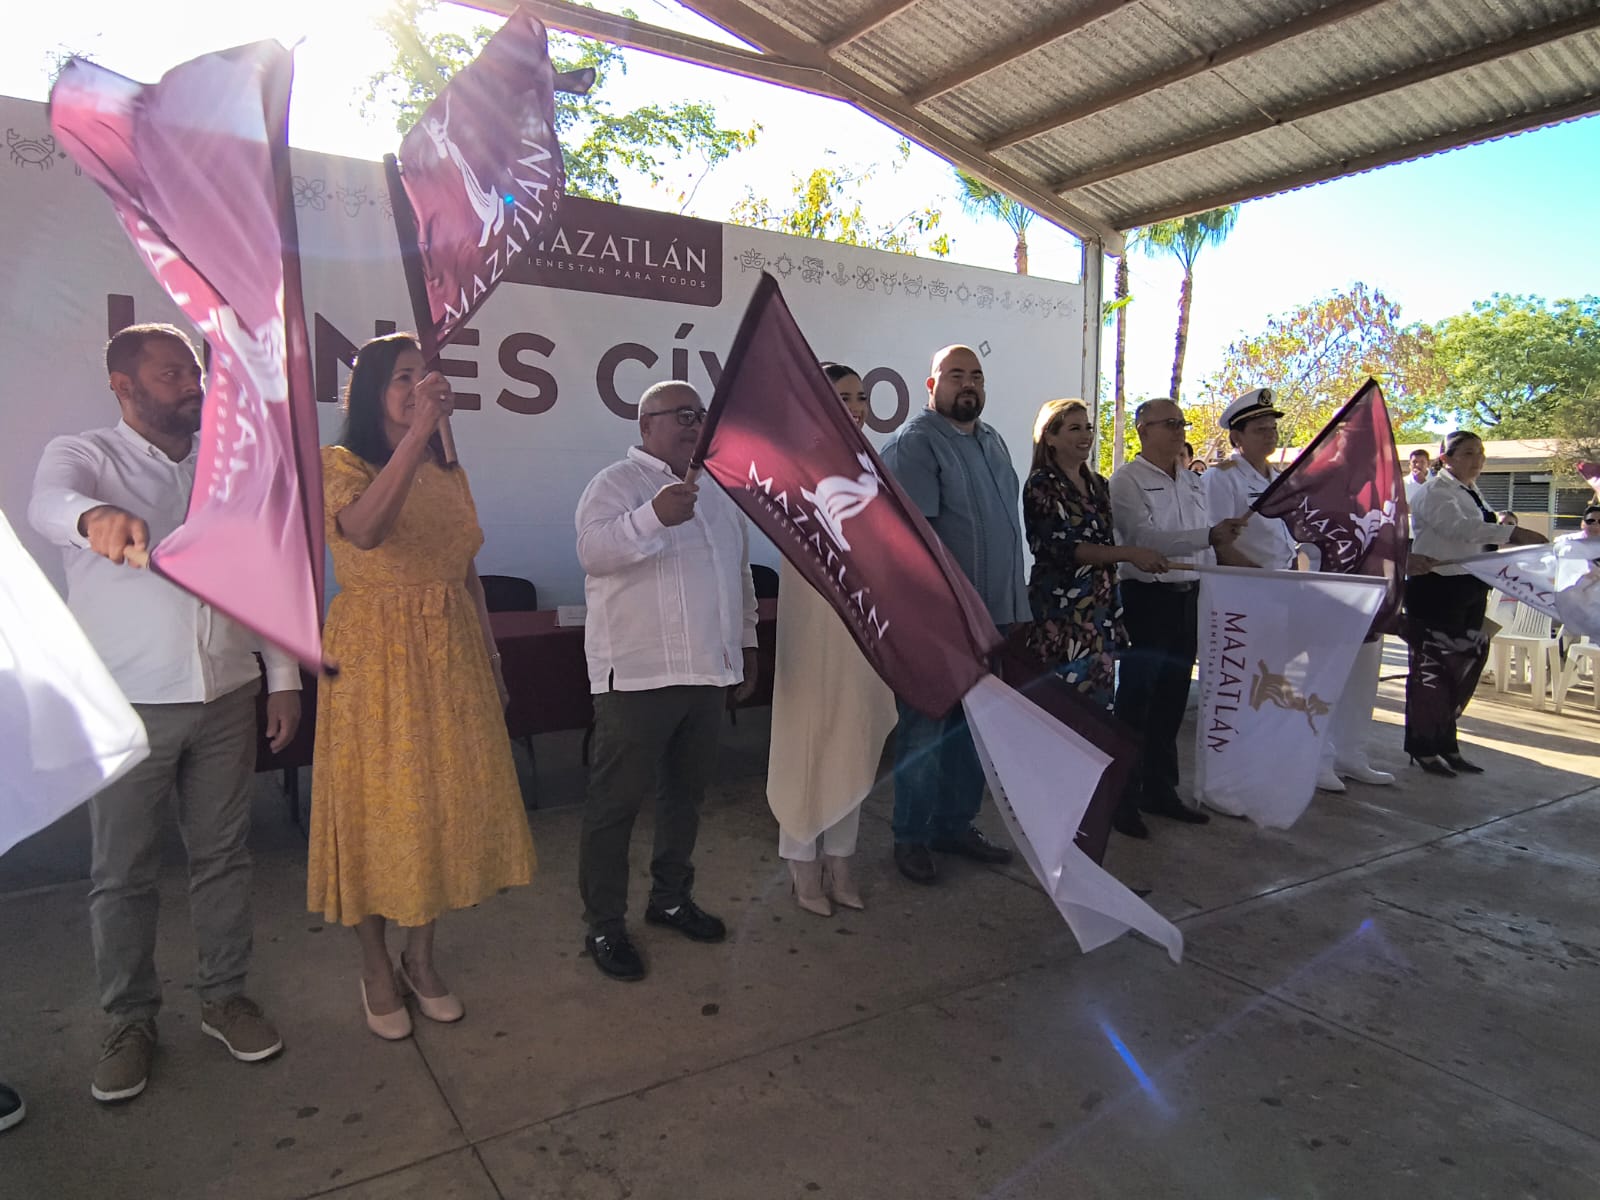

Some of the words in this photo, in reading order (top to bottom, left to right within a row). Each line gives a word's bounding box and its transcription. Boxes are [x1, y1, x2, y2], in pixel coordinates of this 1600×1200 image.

[443, 138, 553, 324] MAZATLÁN
[528, 257, 605, 275] IENESTAR
[615, 269, 651, 281] PARA
[660, 275, 706, 288] TODOS
[538, 227, 706, 273] AZATLÁN
[108, 293, 559, 415] NES
[596, 323, 910, 434] CÍO
[748, 460, 890, 640] MAZATLÁN
[1207, 611, 1248, 753] MAZATLÁN
